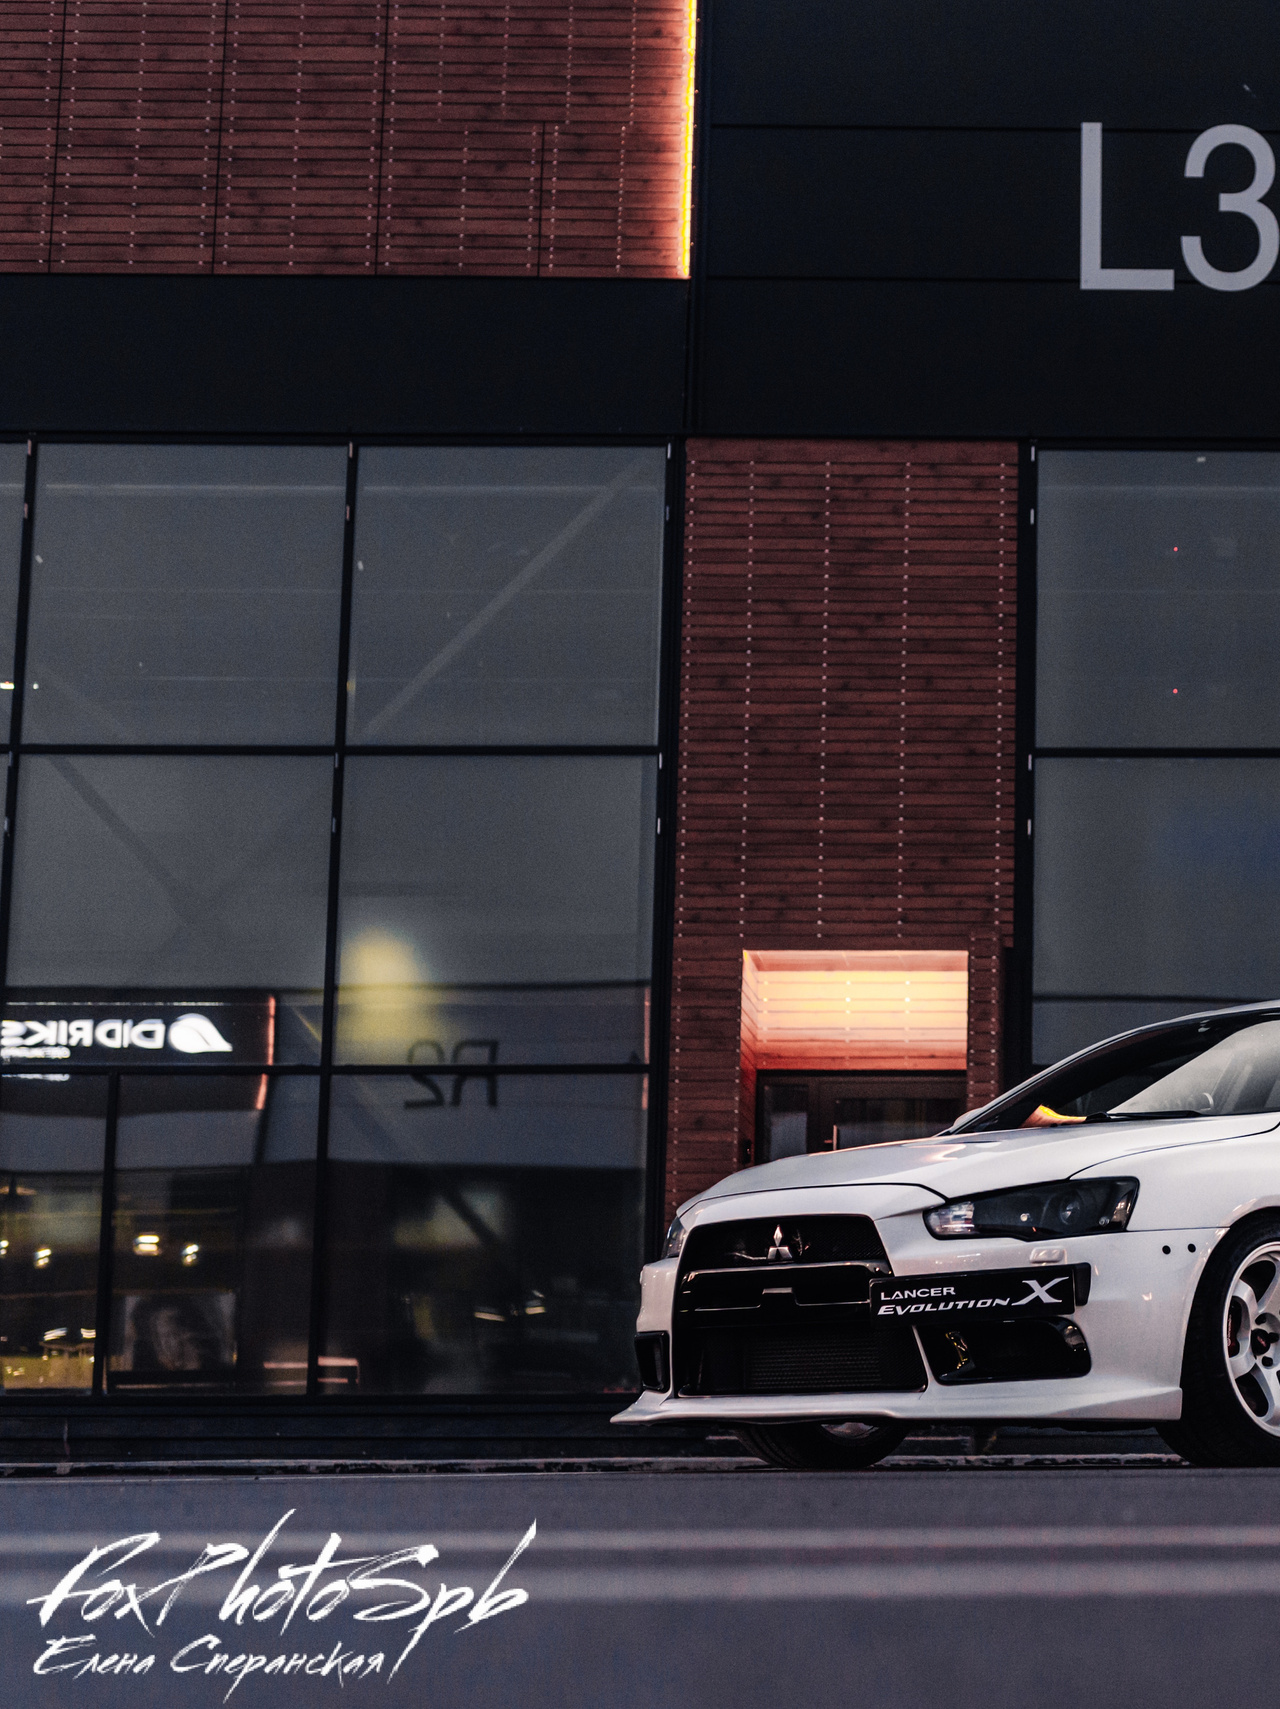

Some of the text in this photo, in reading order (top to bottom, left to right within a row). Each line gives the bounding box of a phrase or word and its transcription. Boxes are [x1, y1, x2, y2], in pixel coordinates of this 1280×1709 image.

[1080, 122, 1280, 291] L3
[877, 1276, 1070, 1316] EVOLUTION X
[880, 1286, 956, 1301] LANCER
